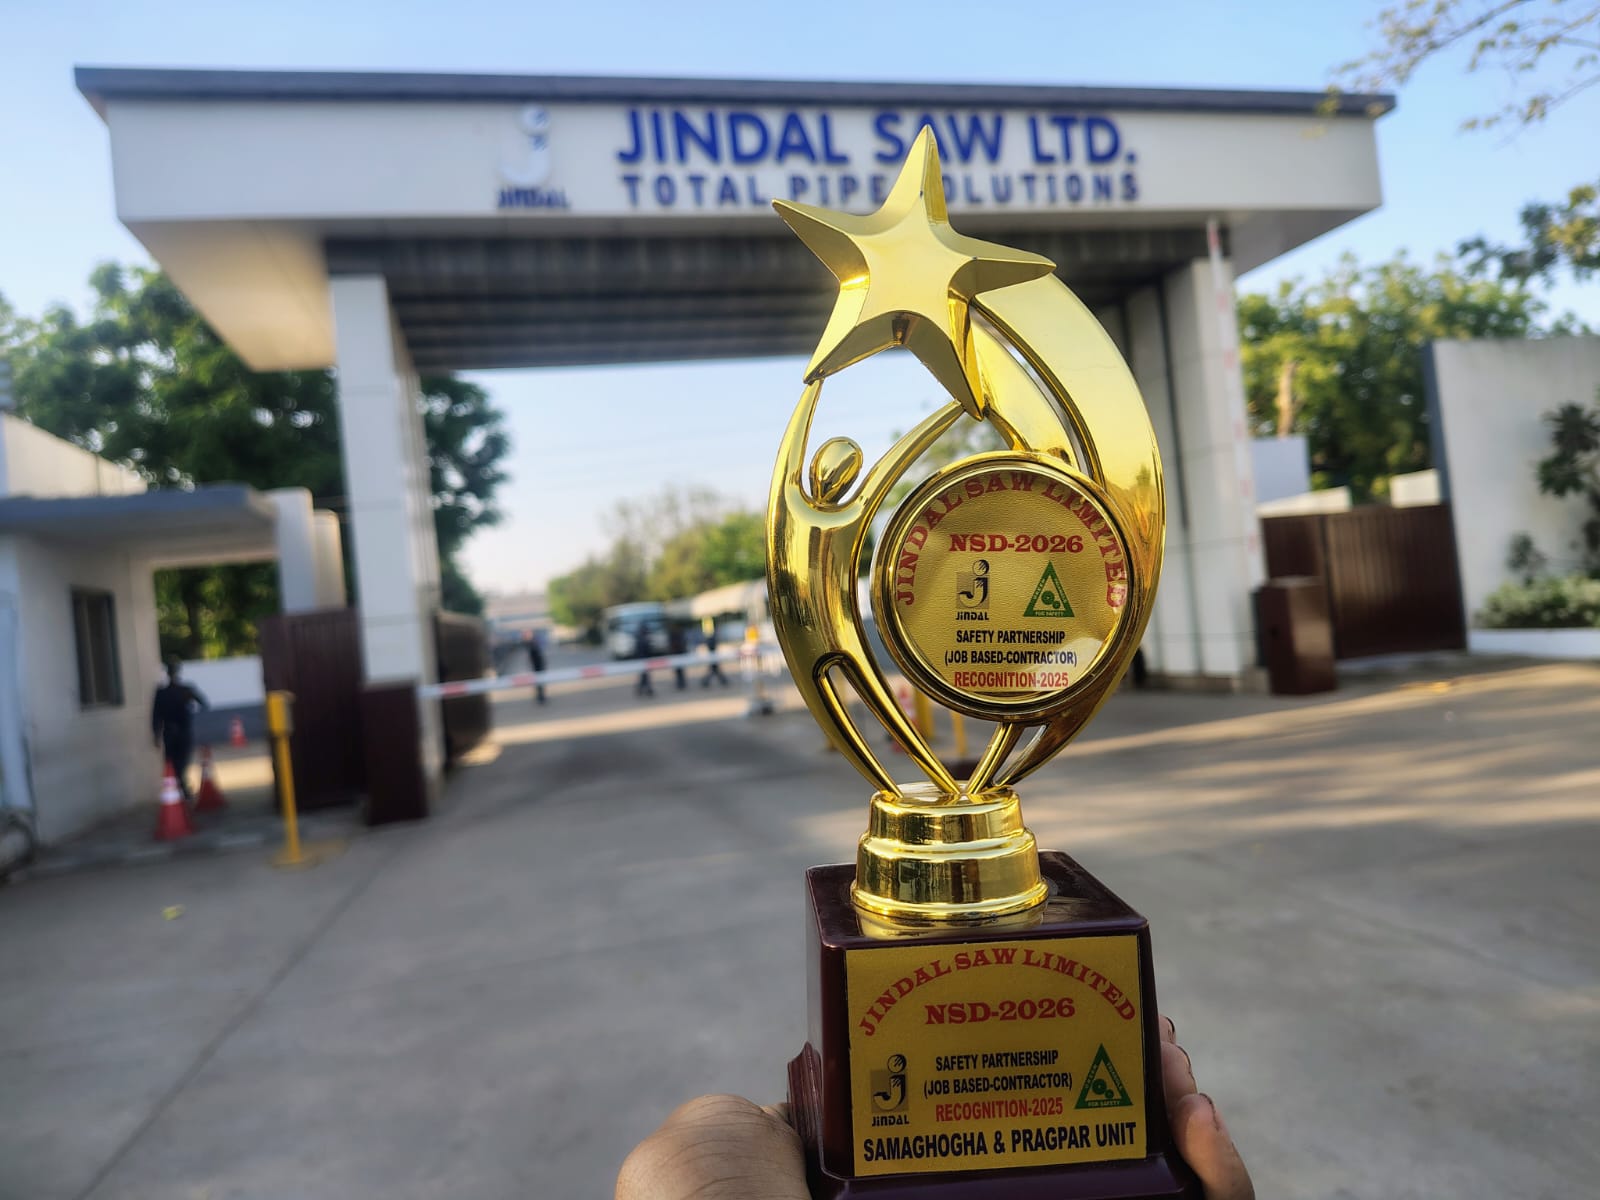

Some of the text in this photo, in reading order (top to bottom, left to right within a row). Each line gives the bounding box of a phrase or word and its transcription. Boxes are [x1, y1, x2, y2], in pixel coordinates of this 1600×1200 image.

[616, 108, 849, 165] JINDAL
[1028, 114, 1138, 166] LTD.
[621, 173, 772, 210] TOTAL
[789, 173, 887, 205] PIPE
[896, 471, 1128, 608] JINDAL SAW LIMITED
[949, 533, 1084, 553] NSD-2026
[956, 630, 1066, 644] SAFETY PARTNERSHIP
[944, 650, 1078, 666] (JOB BASED-CONTRACTOR)
[954, 671, 1069, 688] RECOGNITION-2025
[858, 948, 1136, 1037] JINDAL SAW LIMITED
[925, 998, 1076, 1025] NSD-2026
[935, 1050, 1059, 1072] SAFETY PARTNERSHIP
[923, 1072, 1073, 1099] (JOB BASED-CONTRACTOR)
[935, 1097, 1063, 1123] RECOGNITION-2025
[863, 1122, 1137, 1163] SAMAGHOGHA & PRAGPAR UNIT
